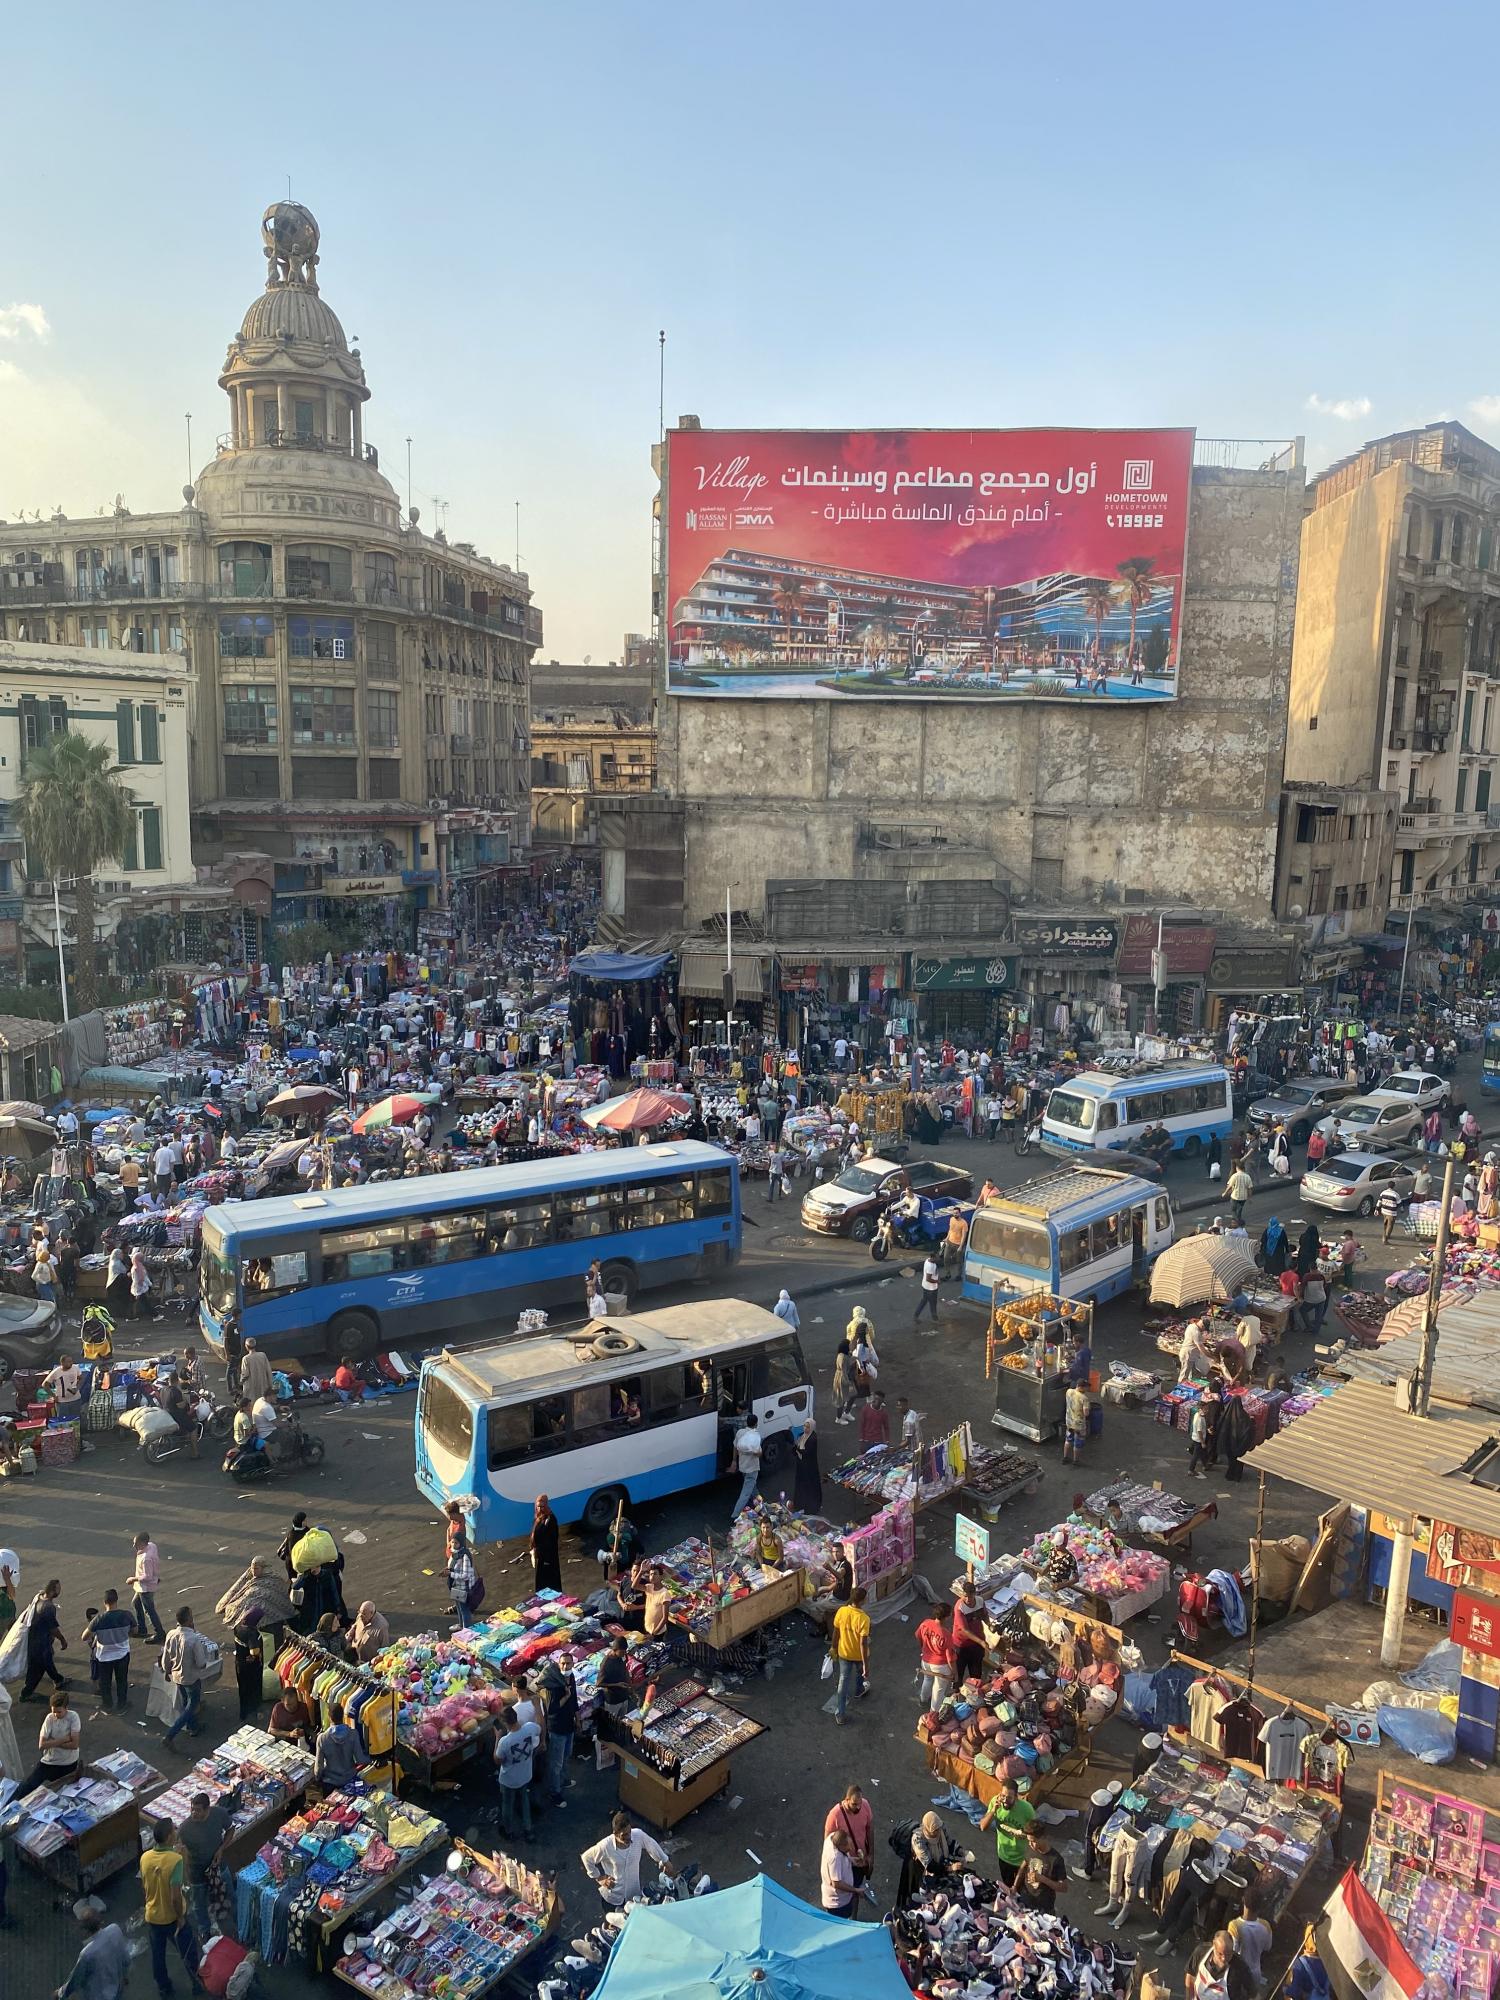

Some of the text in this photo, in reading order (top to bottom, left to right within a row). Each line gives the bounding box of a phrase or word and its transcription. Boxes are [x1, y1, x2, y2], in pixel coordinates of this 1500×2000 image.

[694, 455, 769, 502] Village
[781, 462, 1098, 496] أول مجمع مطاعم وسينمات
[267, 494, 368, 517] TIRING
[1105, 493, 1168, 503] HOMETOWN
[699, 513, 728, 521] HASSAN
[823, 501, 1050, 528] أمام فندق الماسة مباشرة
[1116, 514, 1164, 528] 19992
[1019, 926, 1113, 945] شعراوي
